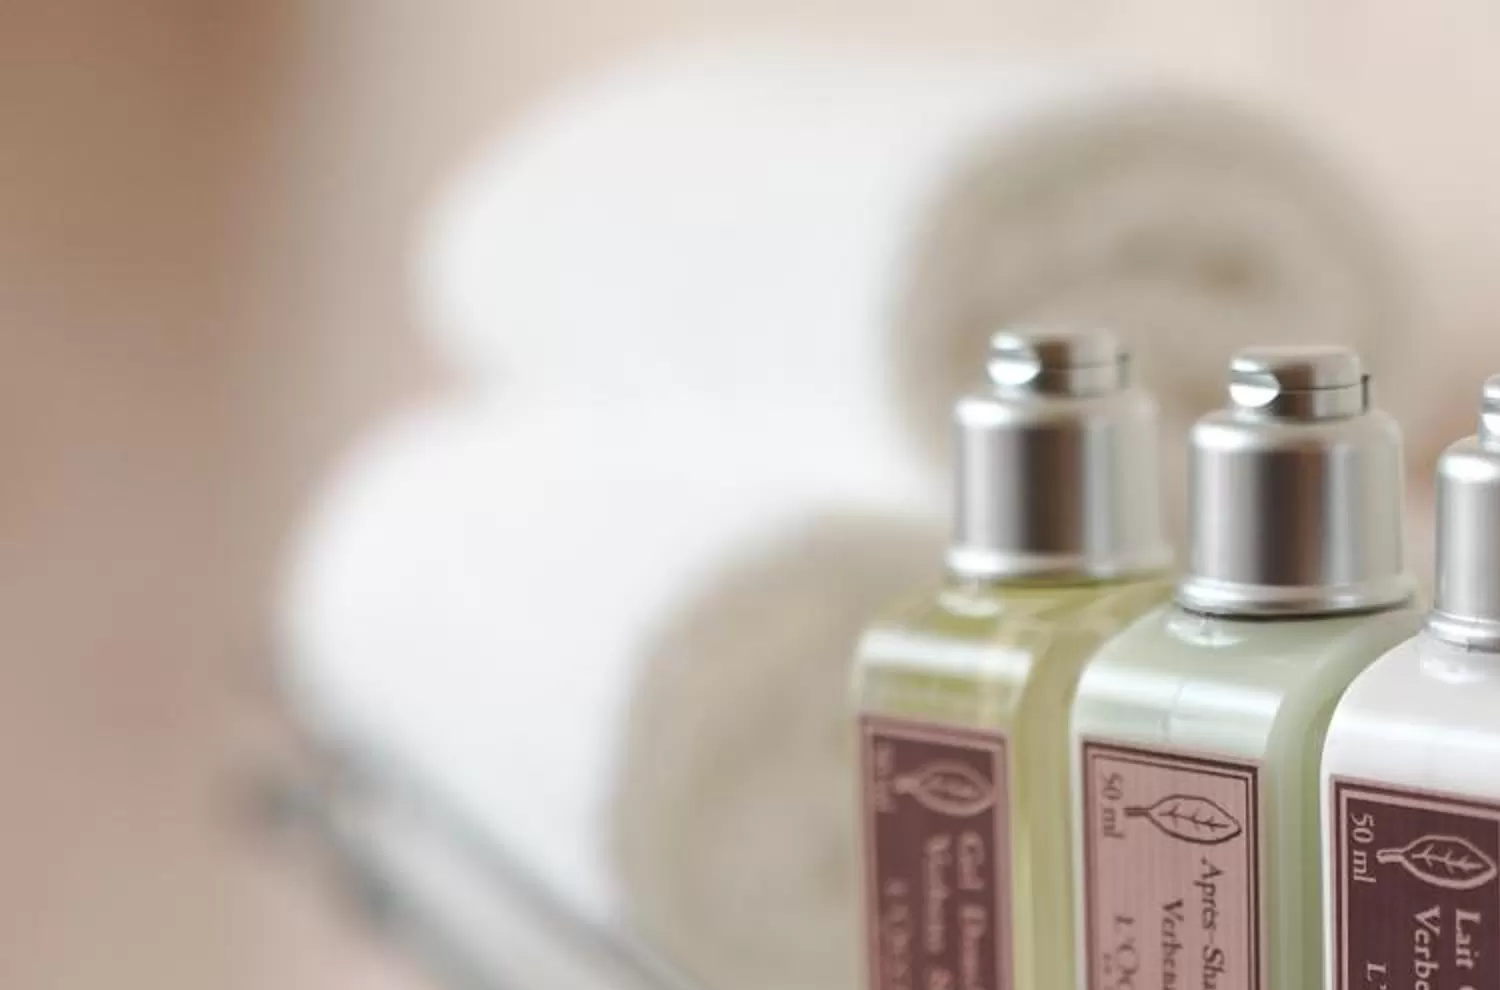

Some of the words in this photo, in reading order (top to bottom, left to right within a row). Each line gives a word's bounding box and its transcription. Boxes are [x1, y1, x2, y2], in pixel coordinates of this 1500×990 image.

[1103, 806, 1126, 839] ml
[1351, 812, 1375, 843] 50
[1352, 850, 1377, 883] ml
[1455, 908, 1481, 969] Lait
